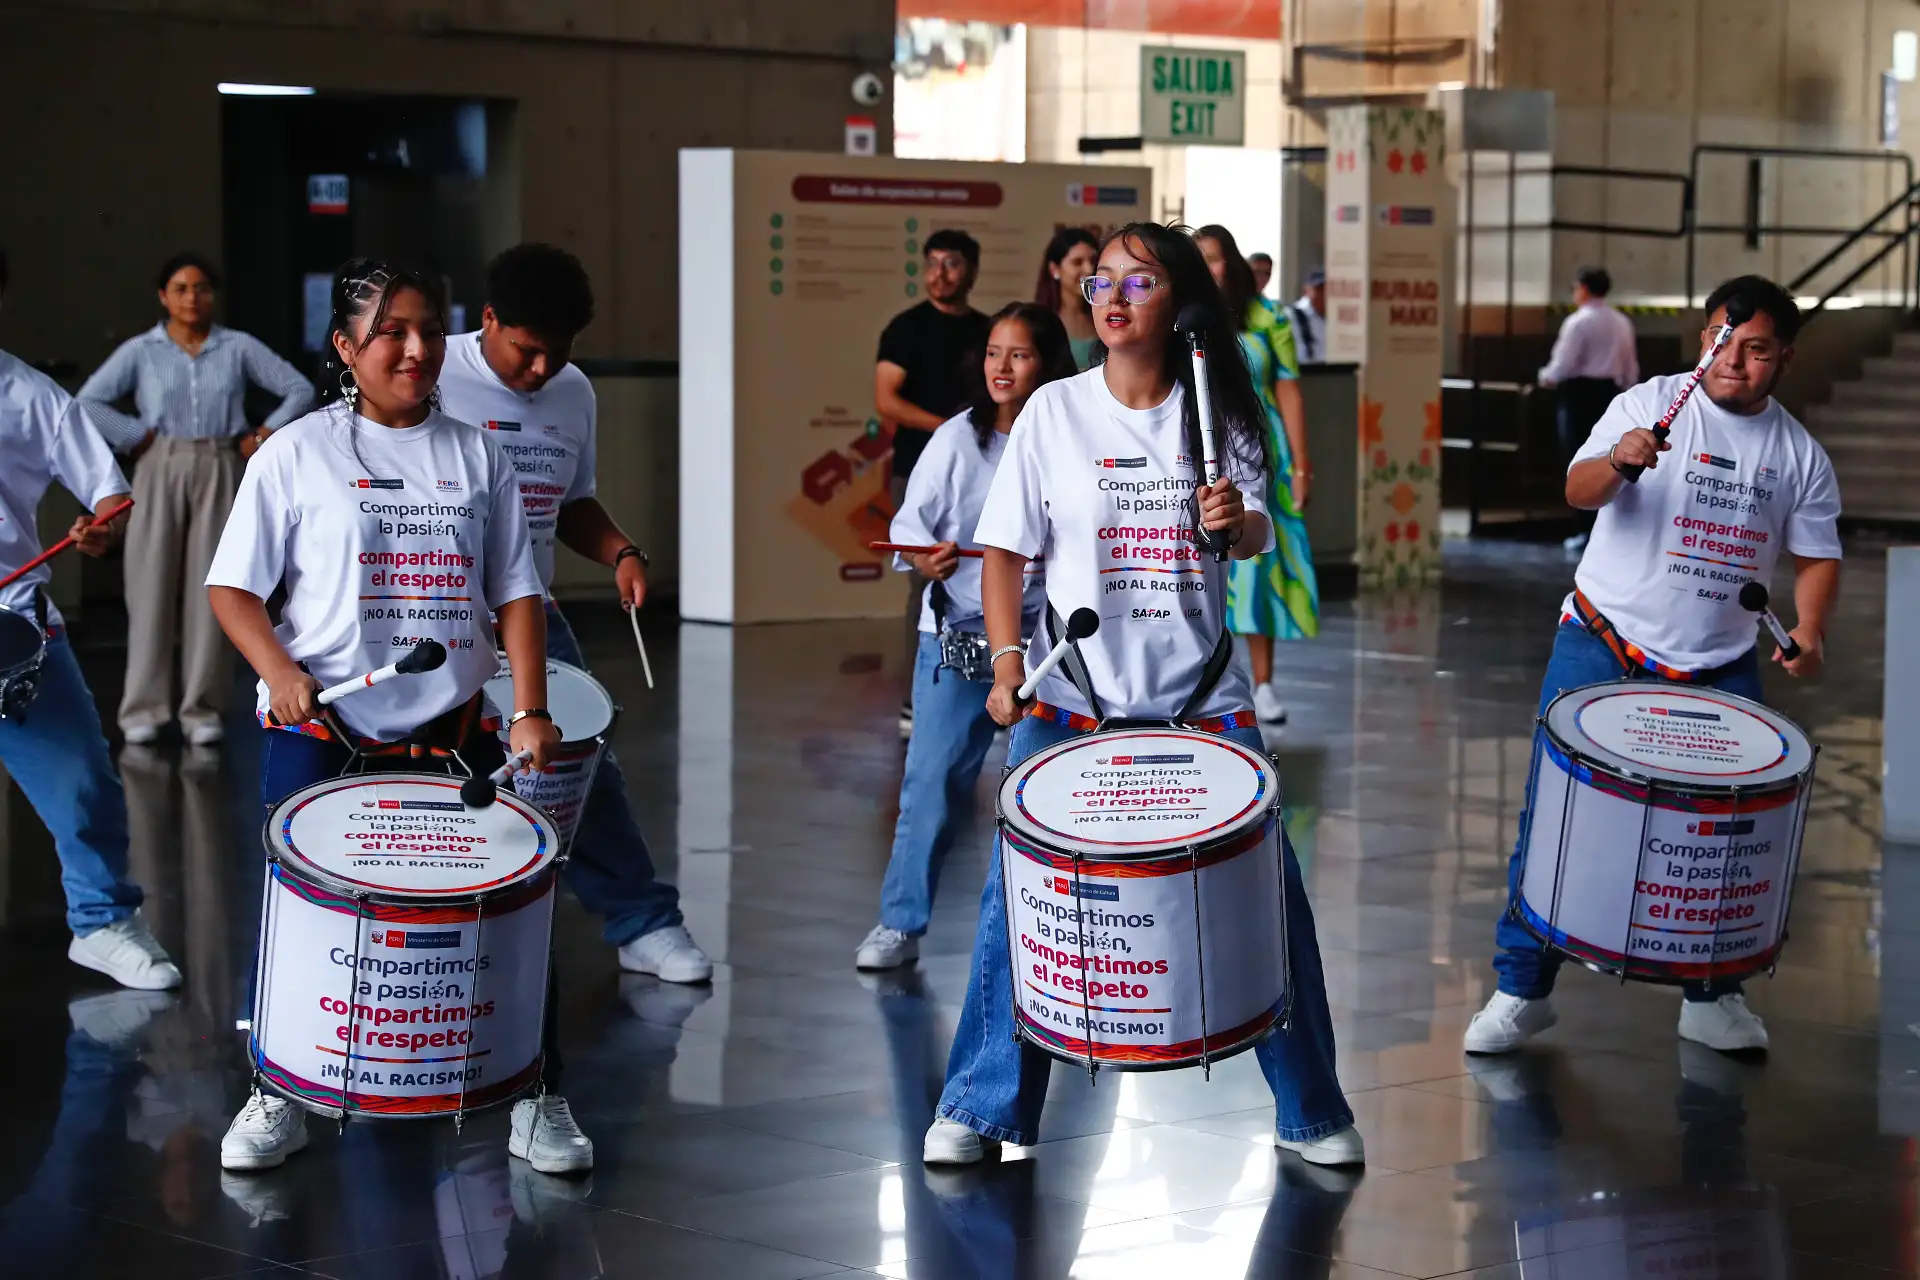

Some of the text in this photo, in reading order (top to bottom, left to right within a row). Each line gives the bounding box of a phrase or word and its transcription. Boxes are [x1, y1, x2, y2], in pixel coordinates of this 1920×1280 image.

[1153, 56, 1233, 96] SALIDA
[1171, 100, 1216, 136] EXIT
[1389, 305, 1438, 327] MAKI
[502, 444, 566, 458] mpartimos
[1685, 471, 1772, 500] Compartimos
[360, 501, 475, 519] Compartimos
[1117, 496, 1130, 511] la
[1696, 491, 1759, 516] la pasión,
[379, 519, 460, 539] la pasión,
[1674, 516, 1768, 543] compartimos
[1112, 543, 1127, 558] el
[1682, 534, 1756, 559] el respeto
[358, 548, 474, 569] compartimos
[371, 569, 466, 591] el respeto
[1668, 564, 1690, 574] ¡NO
[1693, 569, 1706, 578] AL
[1106, 579, 1207, 594] ¡NO AL RACISMO!
[364, 608, 473, 622] ¡NO AL RACISMO!
[1132, 608, 1170, 618] SAFAP
[1626, 714, 1731, 731] Compartimos
[1623, 728, 1740, 746] compartimos
[1658, 739, 1727, 751] respeto
[1081, 768, 1202, 779] Compartimos
[1099, 777, 1182, 788] la pasión,
[1072, 787, 1208, 798] compartimos
[1086, 797, 1191, 807] el respeto
[349, 813, 476, 825] Compartimos
[370, 822, 458, 833] la pasión,
[1074, 816, 1101, 824] ¡NO
[1128, 813, 1200, 821] RACISMO!
[344, 832, 488, 844] compartimos
[361, 842, 472, 853] el respeto
[409, 861, 484, 869] RACISMO!
[1666, 861, 1683, 878] la
[1056, 881, 1067, 890] PERÚ
[1021, 888, 1155, 928] Compartimos
[1649, 903, 1755, 925] el respeto
[1036, 917, 1132, 953] la pasión,
[1021, 933, 1169, 974] compartimos
[1632, 938, 1662, 951] ¡NO
[1666, 942, 1686, 954] AL
[330, 947, 490, 978] Compartimos
[1032, 963, 1149, 999] el respeto
[377, 980, 464, 1001] pasión,
[319, 996, 495, 1026] compartimos
[1029, 999, 1164, 1036] ¡NO AL RACISMO!
[336, 1024, 473, 1052] el respeto
[321, 1064, 483, 1086] ¡NO AL RACISMO!
